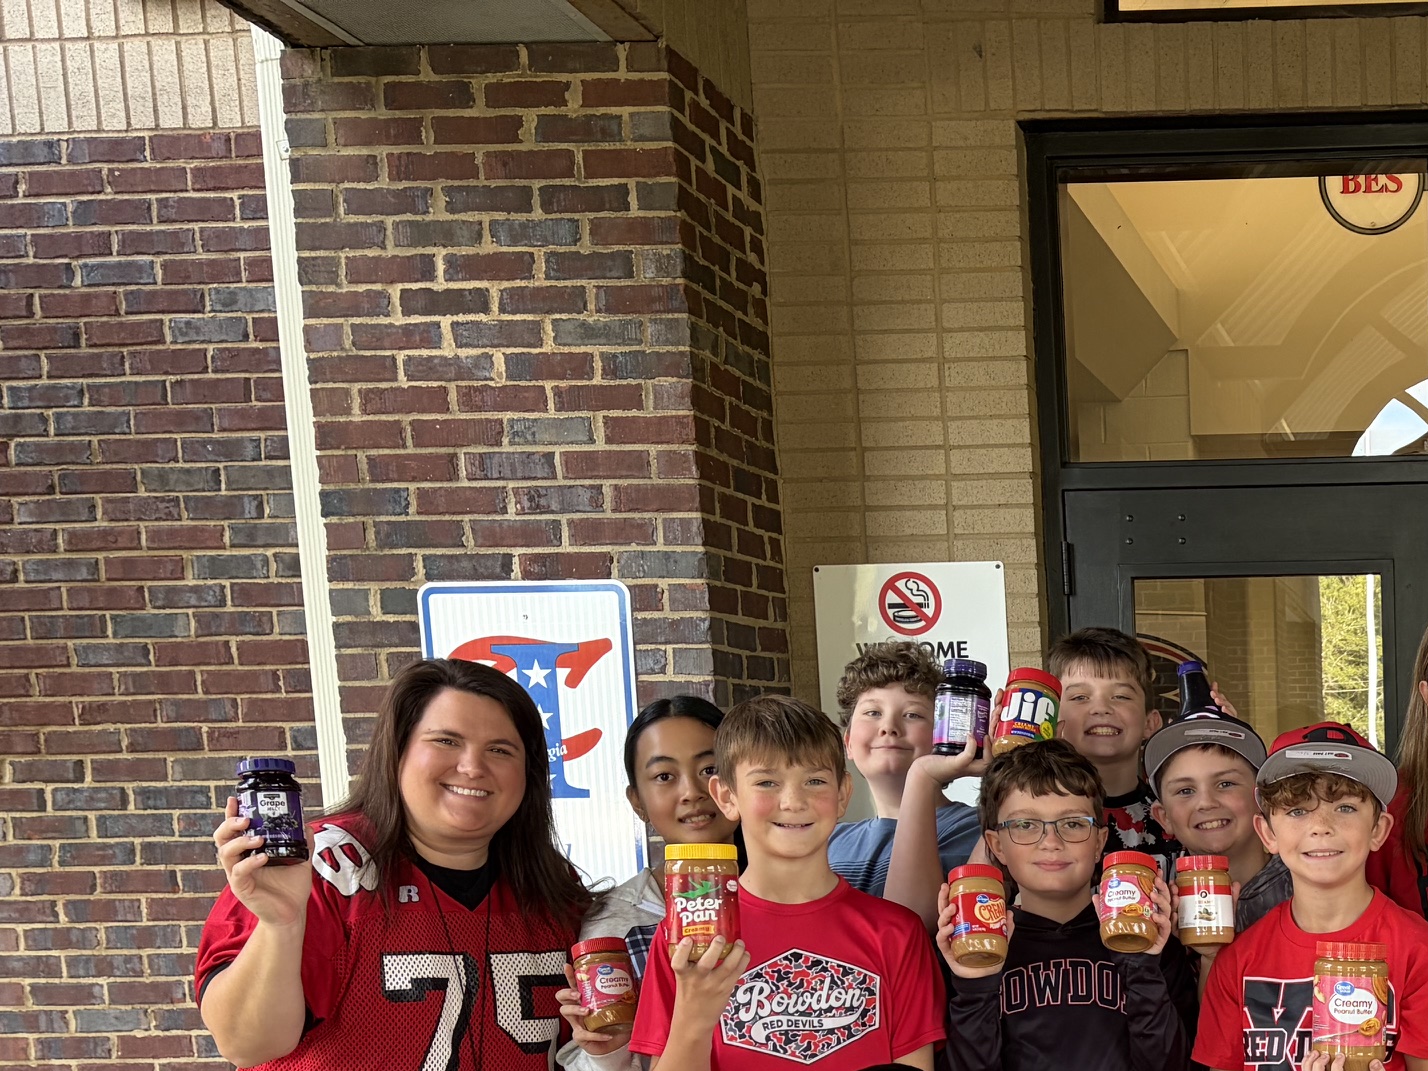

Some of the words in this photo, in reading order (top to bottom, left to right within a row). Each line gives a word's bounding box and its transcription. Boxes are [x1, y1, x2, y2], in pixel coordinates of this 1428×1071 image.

[259, 799, 286, 808] Grape
[398, 885, 420, 903] R
[1107, 889, 1136, 898] Creamy
[674, 897, 723, 912] Peter
[679, 909, 719, 927] Pan
[684, 926, 710, 934] Creamy
[736, 975, 866, 1022] Bowdon
[1334, 998, 1373, 1009] Creamy
[762, 1019, 784, 1032] RED
[786, 1018, 824, 1029] DEVILS
